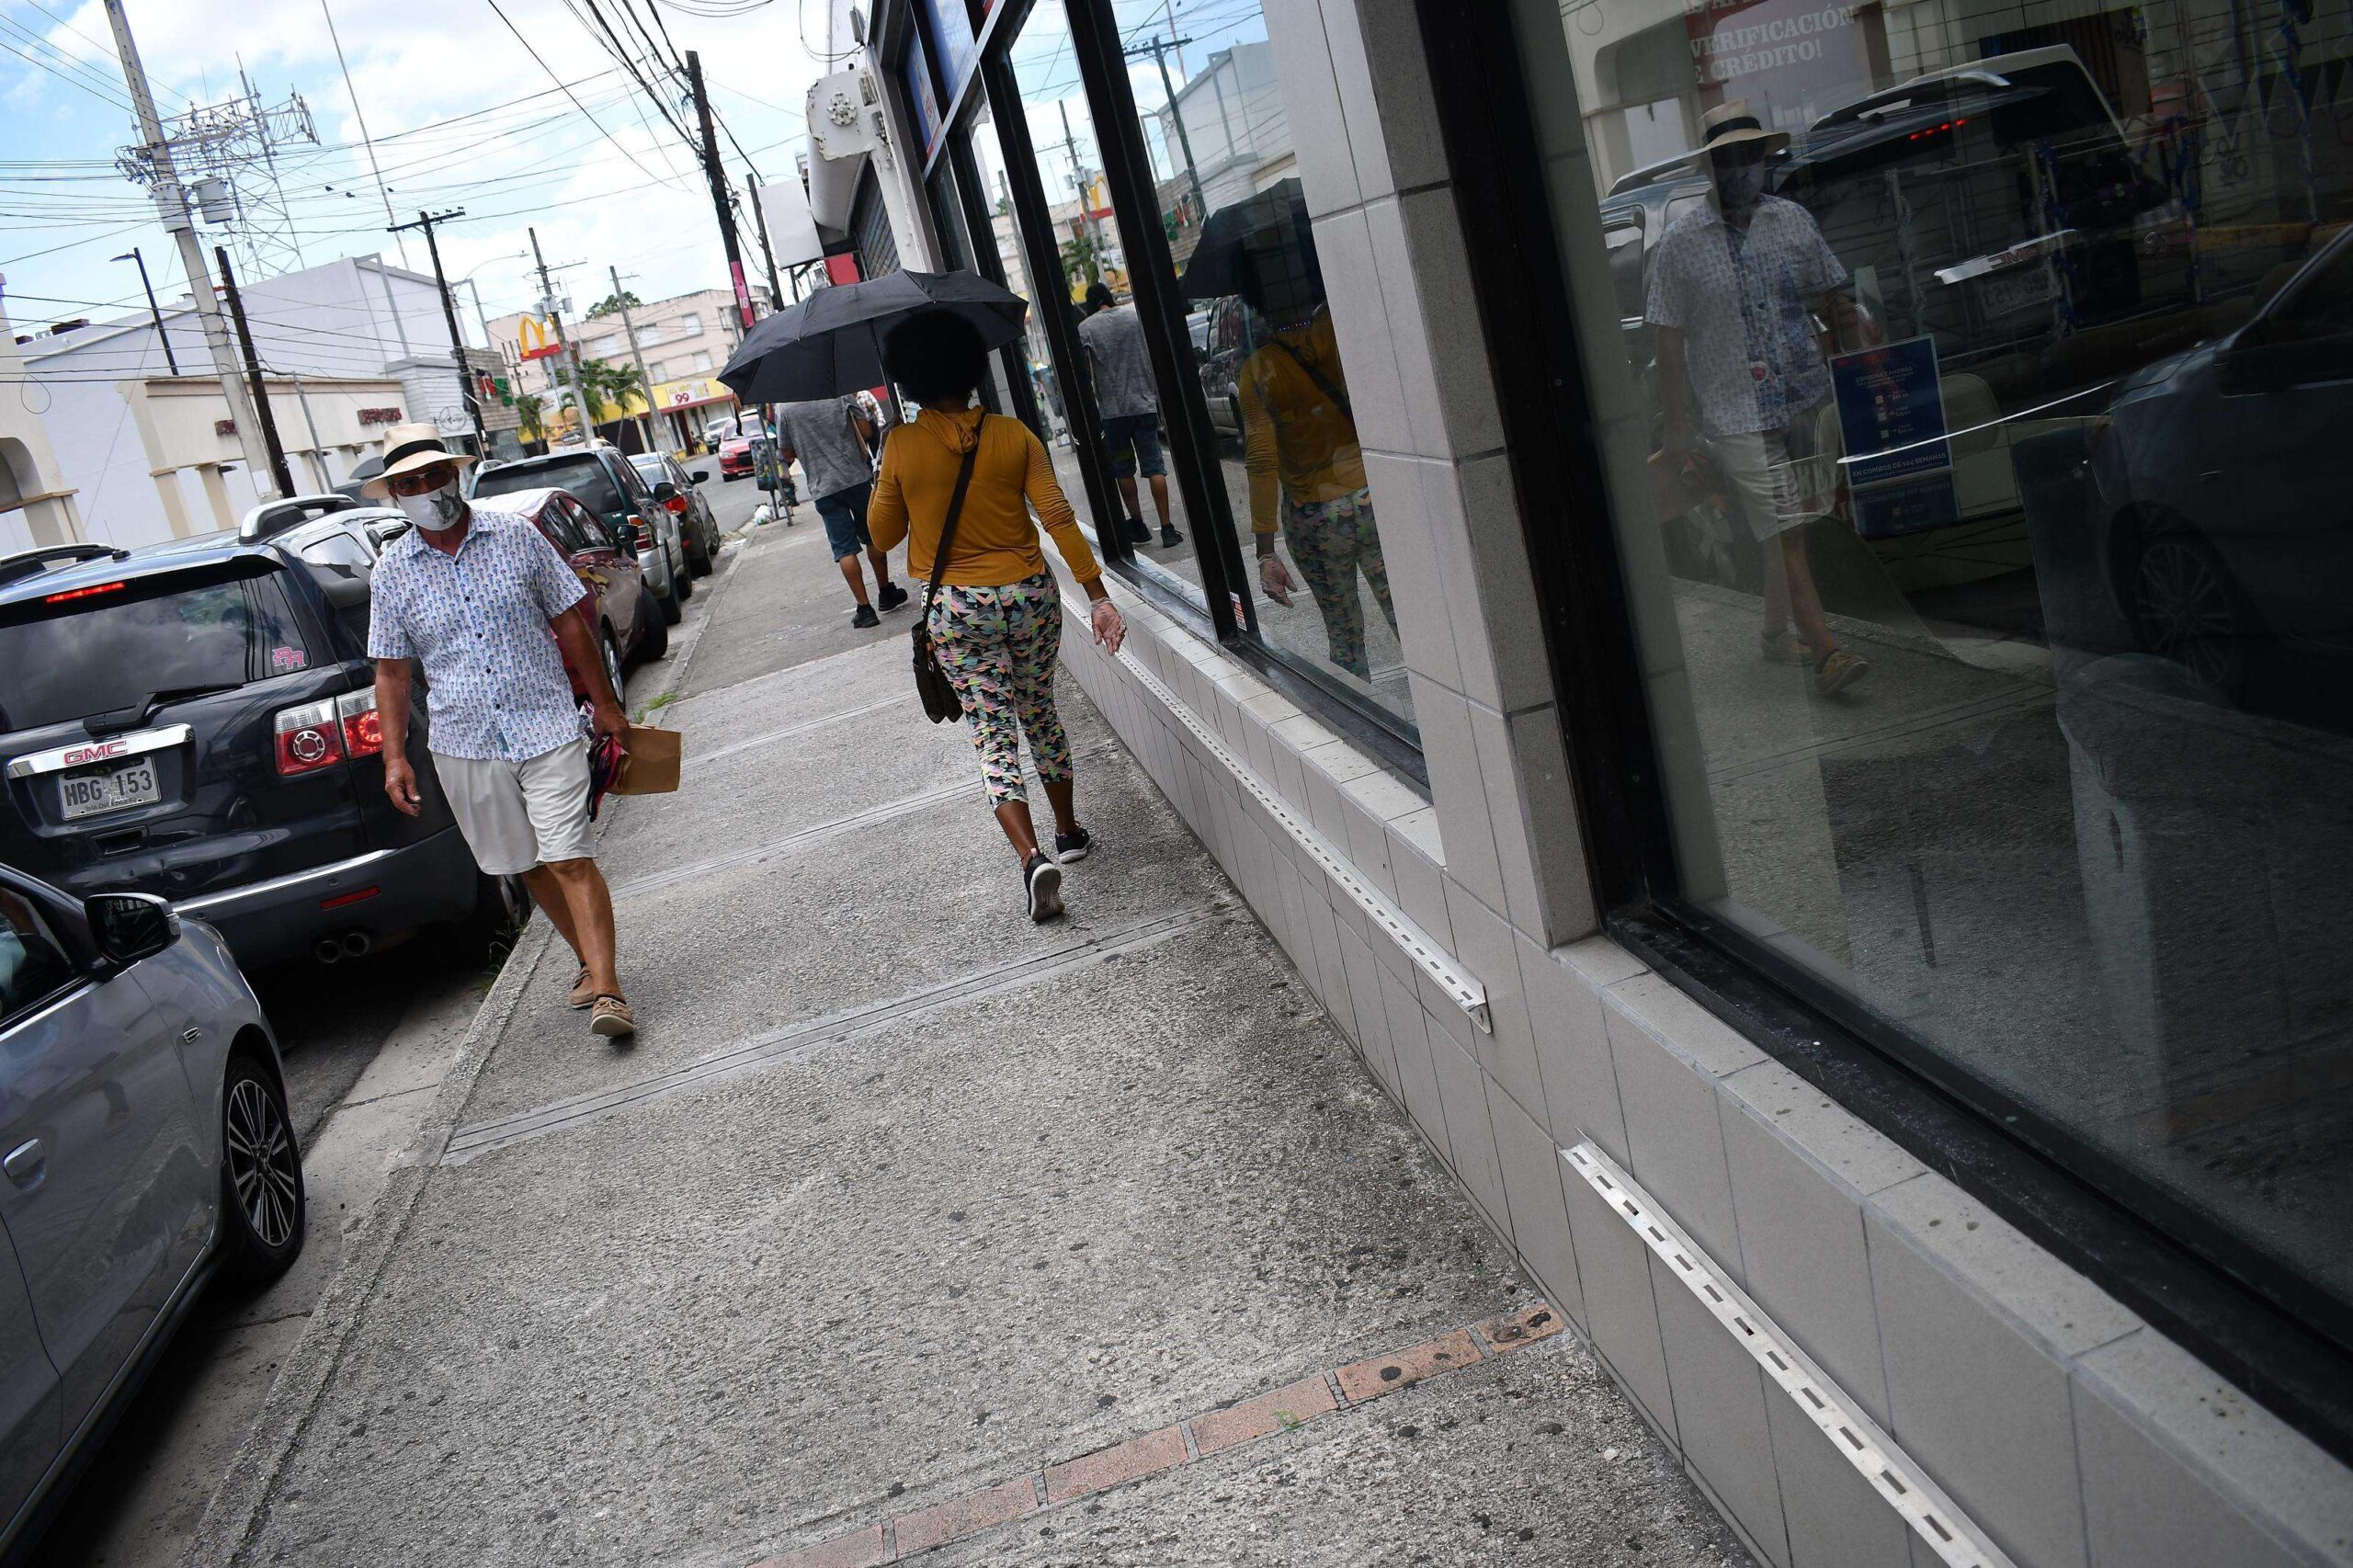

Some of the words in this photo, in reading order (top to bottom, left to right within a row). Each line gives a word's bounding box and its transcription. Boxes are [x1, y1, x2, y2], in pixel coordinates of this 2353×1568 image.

[1690, 4, 1855, 58] VERIFICACIÓN
[1711, 39, 1823, 80] CRÉDITO!
[676, 392, 689, 403] 99
[1863, 464, 1892, 475] COMBOS
[63, 740, 128, 766] GMC
[64, 779, 103, 807] HBG
[117, 770, 153, 796] 153
[86, 803, 97, 812] Isla
